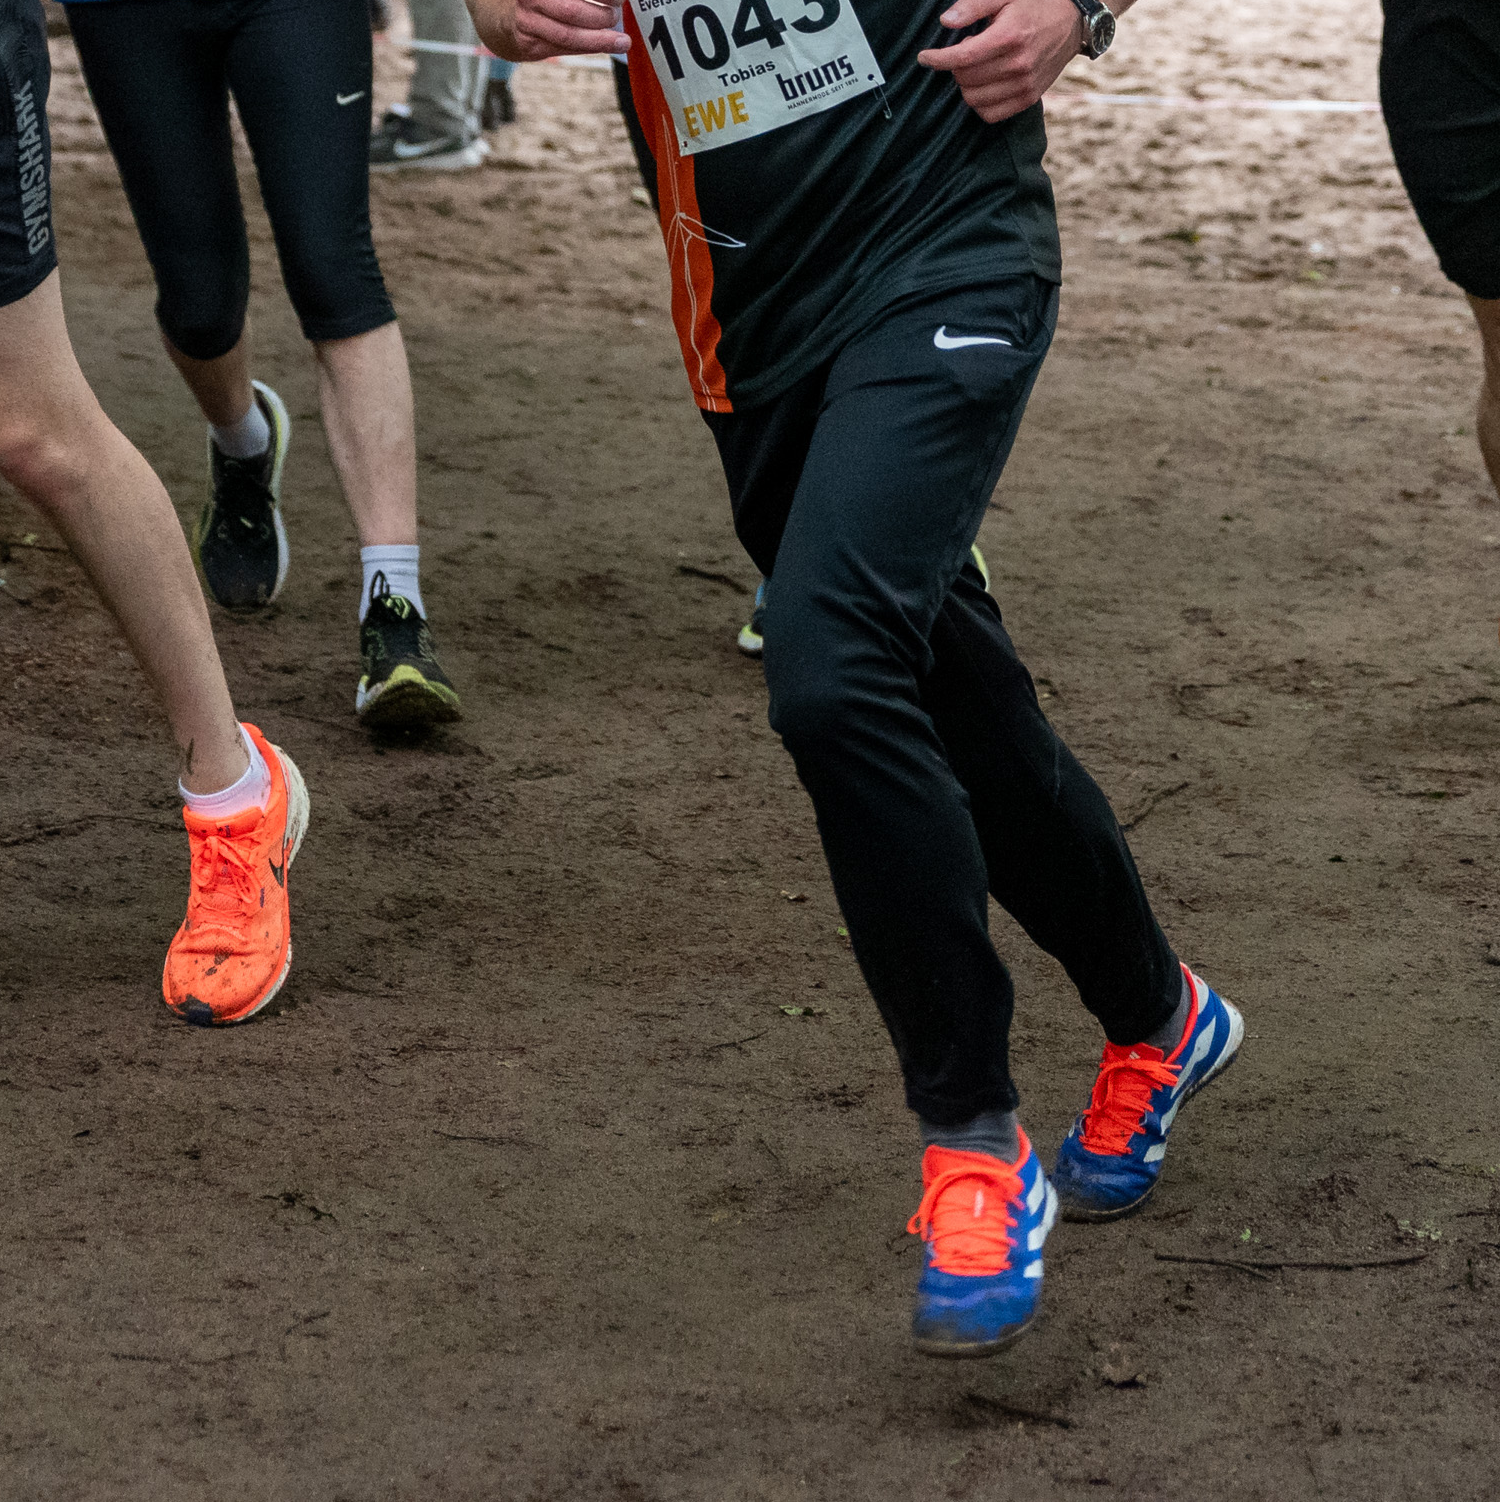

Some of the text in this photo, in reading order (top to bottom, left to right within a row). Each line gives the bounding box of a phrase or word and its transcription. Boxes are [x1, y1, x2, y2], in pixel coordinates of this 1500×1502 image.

[717, 60, 776, 88] Tobias
[775, 54, 855, 102] bruns
[831, 84, 845, 93] SEIT
[683, 90, 750, 138] EWE
[13, 79, 51, 256] GYMSHARK
